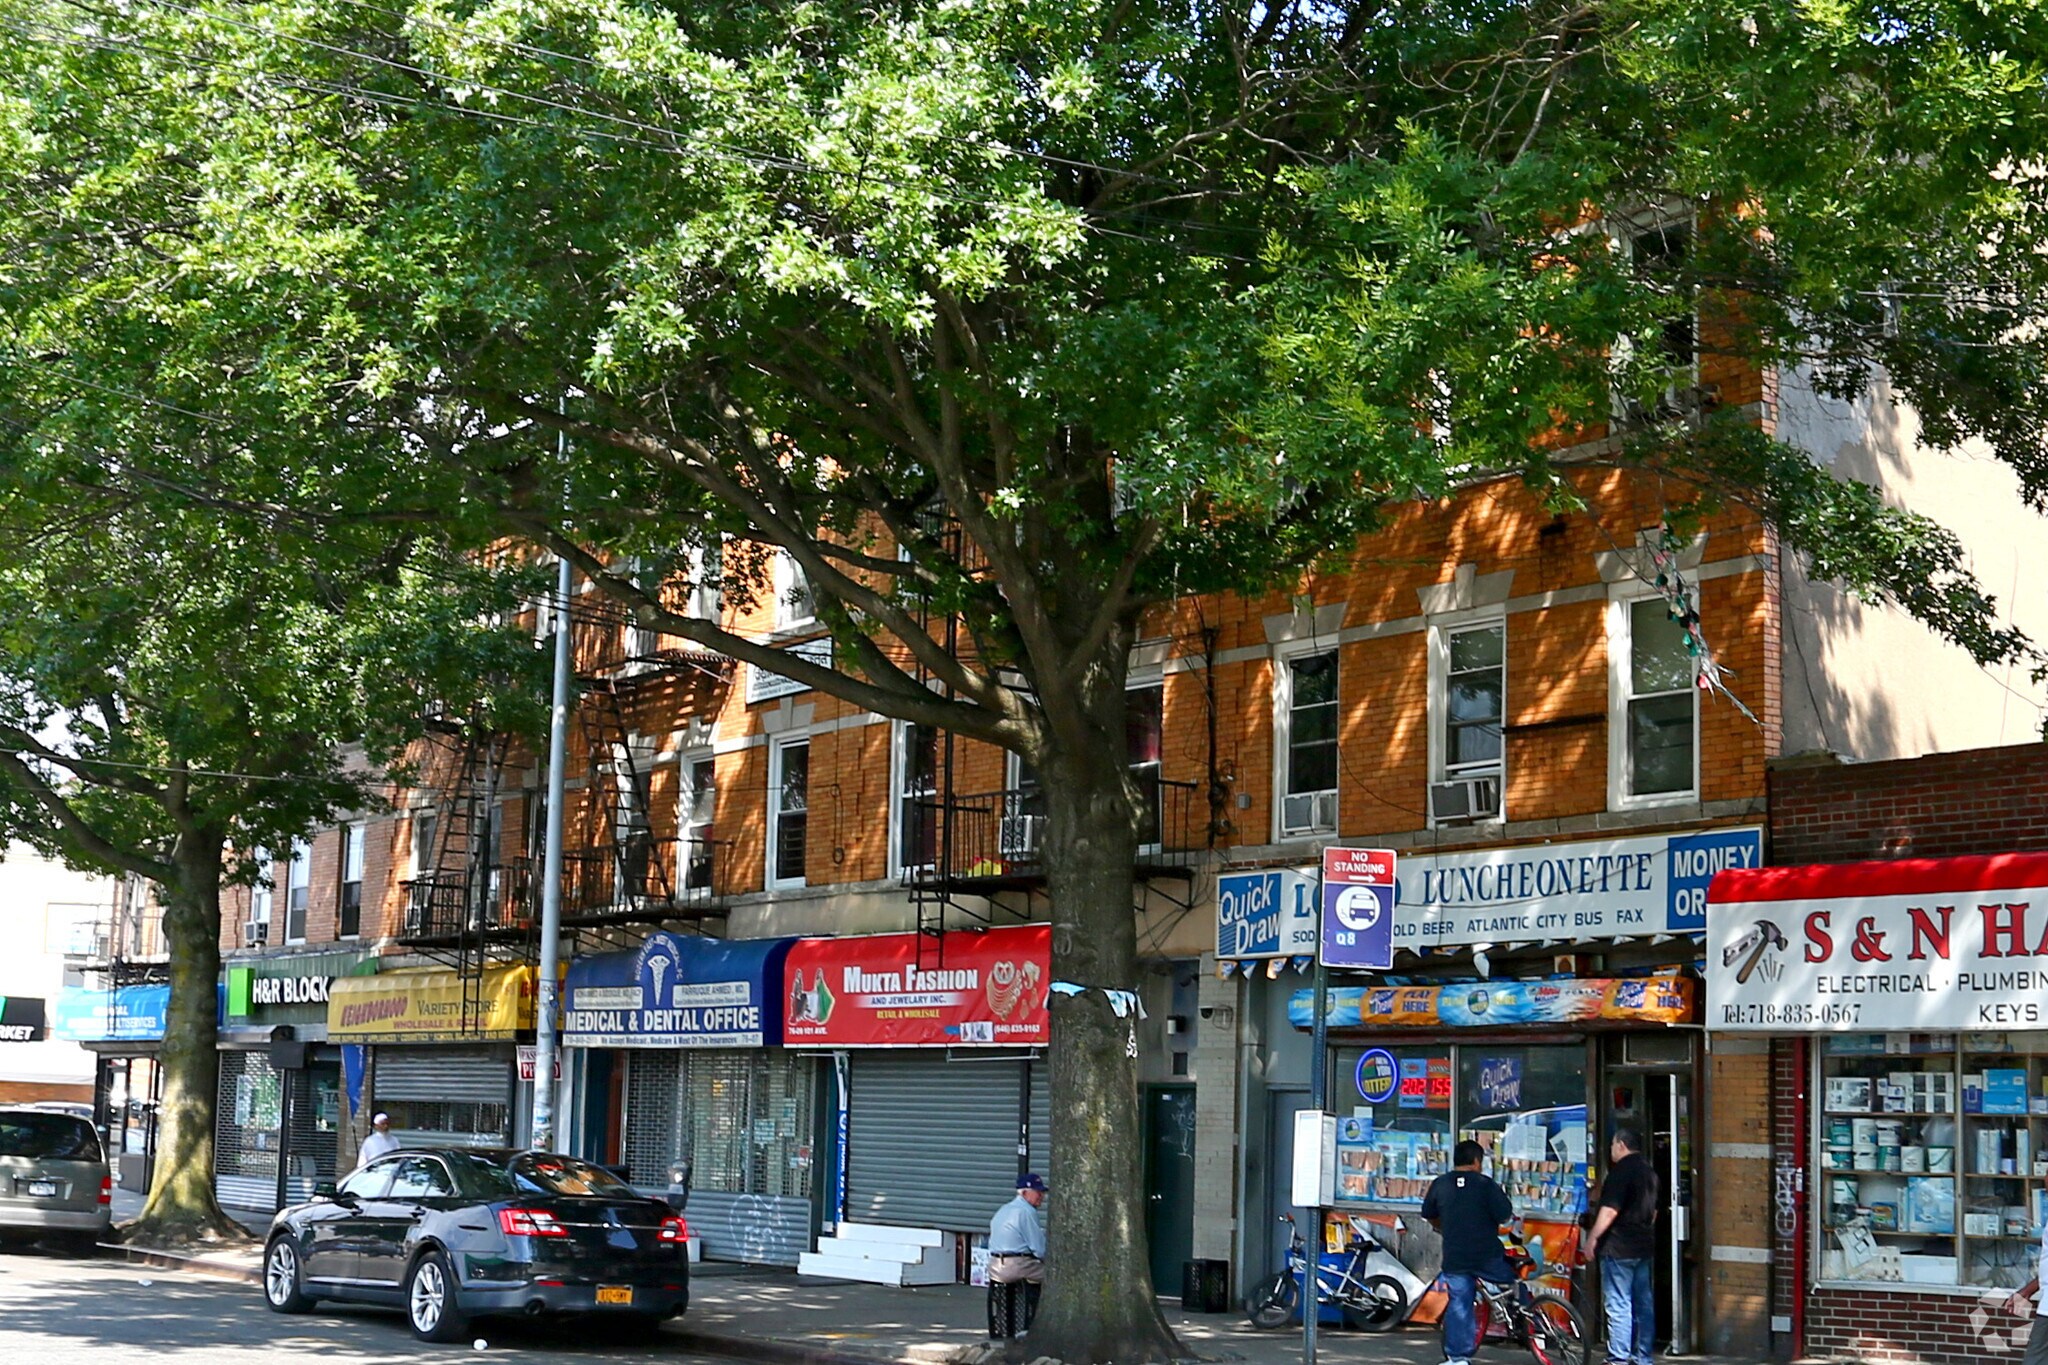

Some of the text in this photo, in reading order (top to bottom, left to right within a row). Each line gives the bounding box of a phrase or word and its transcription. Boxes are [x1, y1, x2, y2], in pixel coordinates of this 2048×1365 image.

[1351, 852, 1368, 862] NO
[1674, 845, 1754, 878] MONEY
[1334, 861, 1385, 874] STANDING
[1422, 853, 1653, 906] LUNCHEONETTE
[1220, 873, 1274, 926] Quick
[1235, 912, 1284, 957] Draw
[1292, 909, 1644, 943] SOD OLD BEER ATLANTIC CITY BUS FAX
[1804, 902, 2048, 963] S & N H
[1336, 932, 1356, 946] Q8
[844, 964, 978, 993] MUKTA FASHION
[1817, 974, 1937, 993] ELECTRICAL
[253, 976, 329, 1003] H&R BLOCK
[1403, 990, 1432, 999] PLAY
[417, 1000, 499, 1016] VARIETY STORE
[871, 994, 947, 1005] AND JEWELARY INC.
[1402, 1001, 1430, 1013] HERE
[566, 1006, 759, 1032] MEDICAL & DENTAL OFFICE
[904, 1009, 940, 1018] WHOLESALE
[1979, 1003, 2038, 1023] KEYS
[393, 1019, 445, 1030] WHOLESALE
[1481, 1058, 1513, 1090] Quick
[1401, 1078, 1426, 1095] 202
[1431, 1078, 1451, 1096] 155
